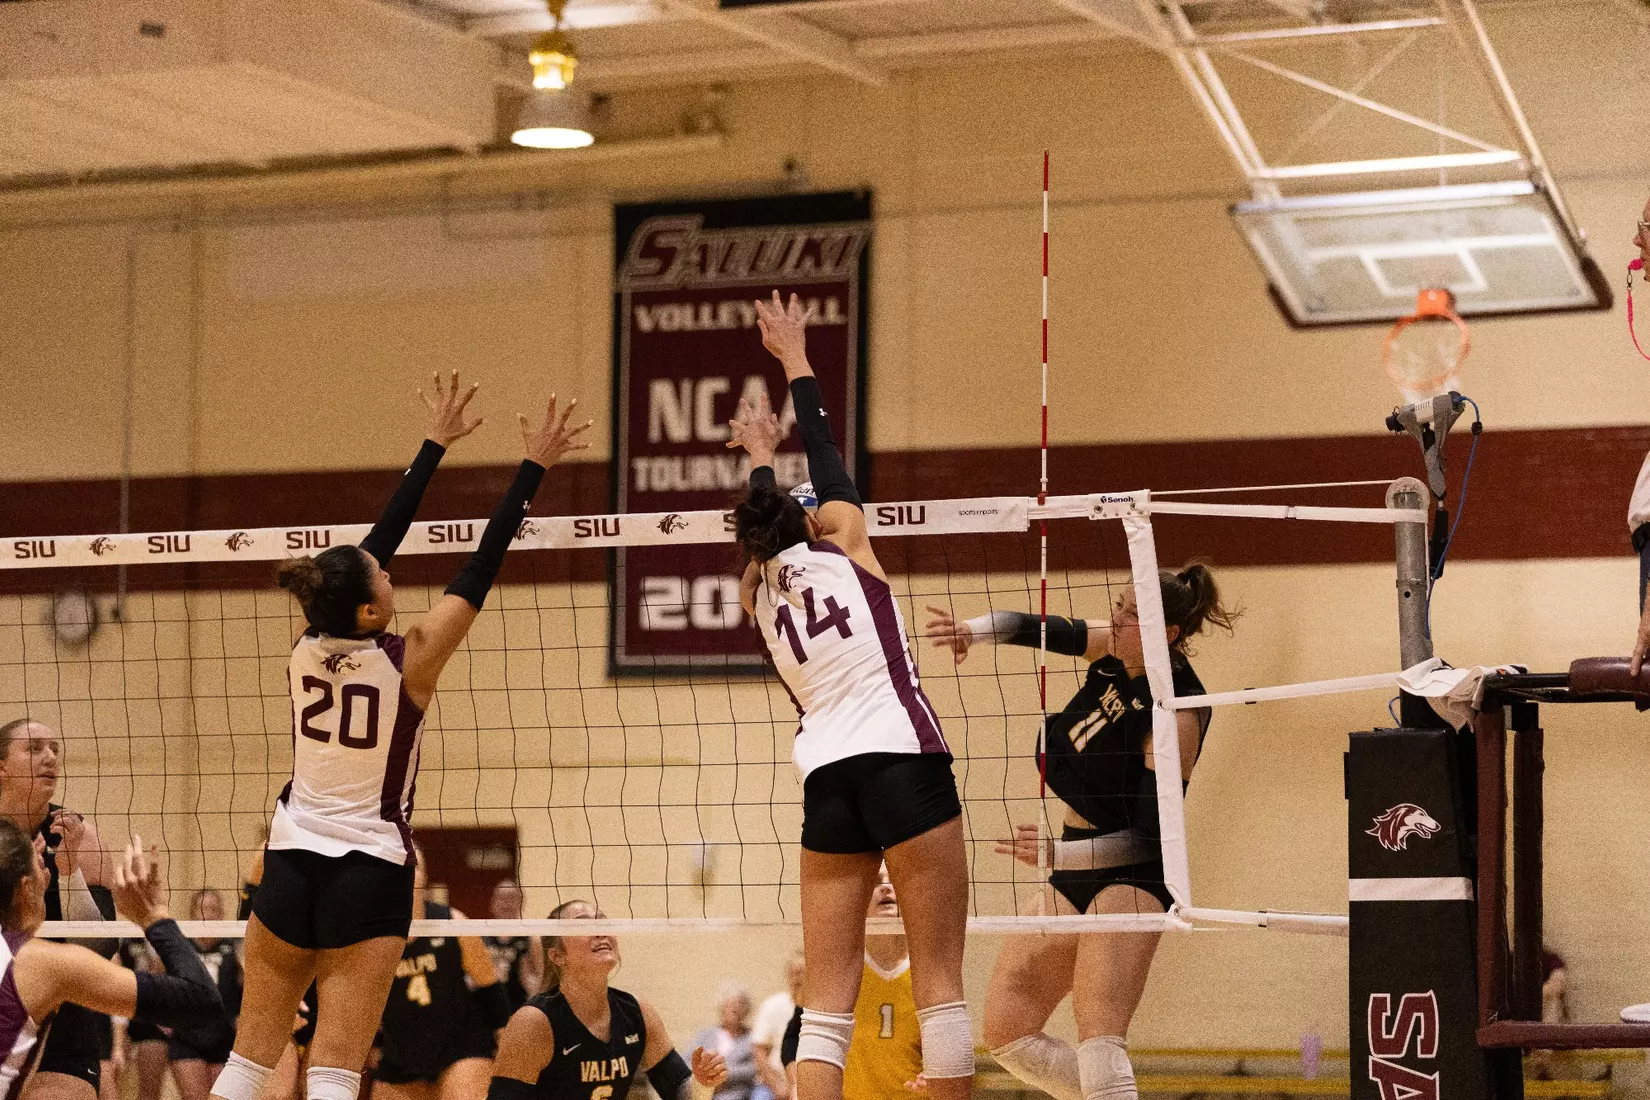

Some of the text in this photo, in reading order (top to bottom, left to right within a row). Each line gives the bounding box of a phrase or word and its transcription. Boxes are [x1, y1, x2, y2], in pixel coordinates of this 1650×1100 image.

[634, 297, 848, 332] VOLLEYLL
[574, 517, 620, 538] SIU
[876, 505, 927, 526] SIU
[147, 534, 191, 554] SIU
[286, 530, 331, 550] SIU
[428, 523, 474, 544] SIU
[14, 540, 56, 559] SIU
[774, 586, 854, 666] 14
[300, 674, 380, 750] 20
[1068, 707, 1108, 753] 11
[406, 974, 431, 1006] 4
[879, 1003, 895, 1039] 1
[580, 1056, 630, 1082] VALPO
